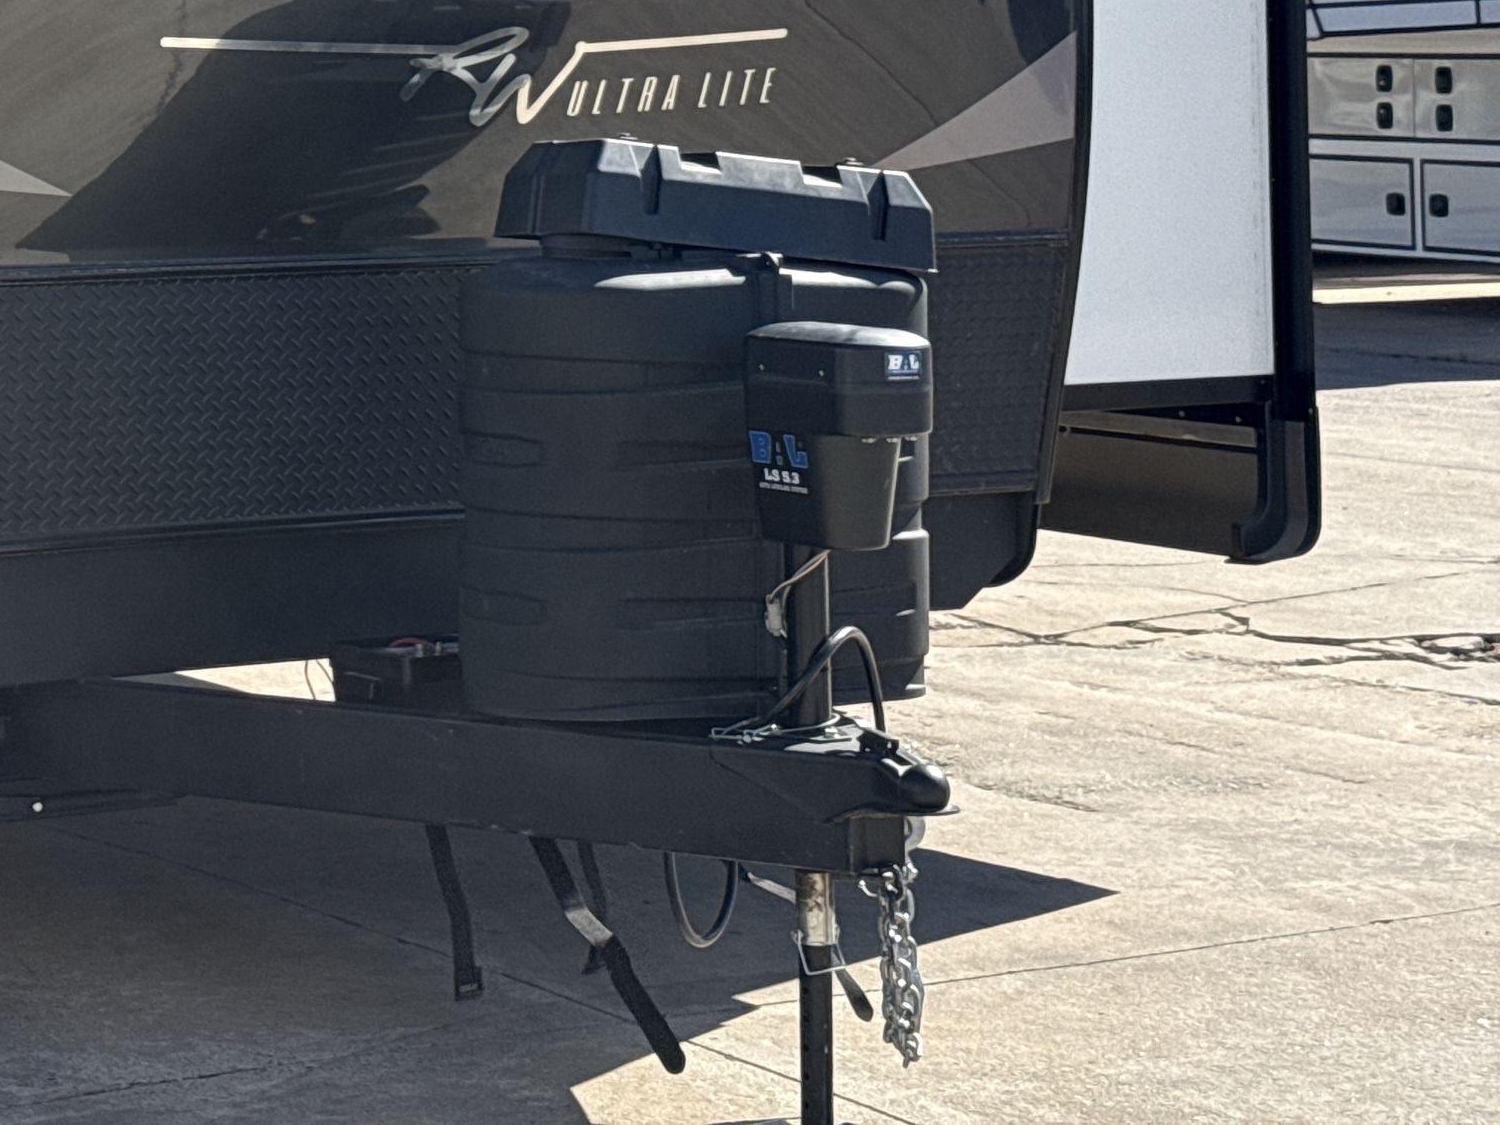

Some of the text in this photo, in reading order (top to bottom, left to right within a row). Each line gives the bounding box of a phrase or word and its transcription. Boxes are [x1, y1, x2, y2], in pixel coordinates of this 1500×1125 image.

[566, 67, 778, 117] ULTRA LITE
[763, 467, 781, 482] LS
